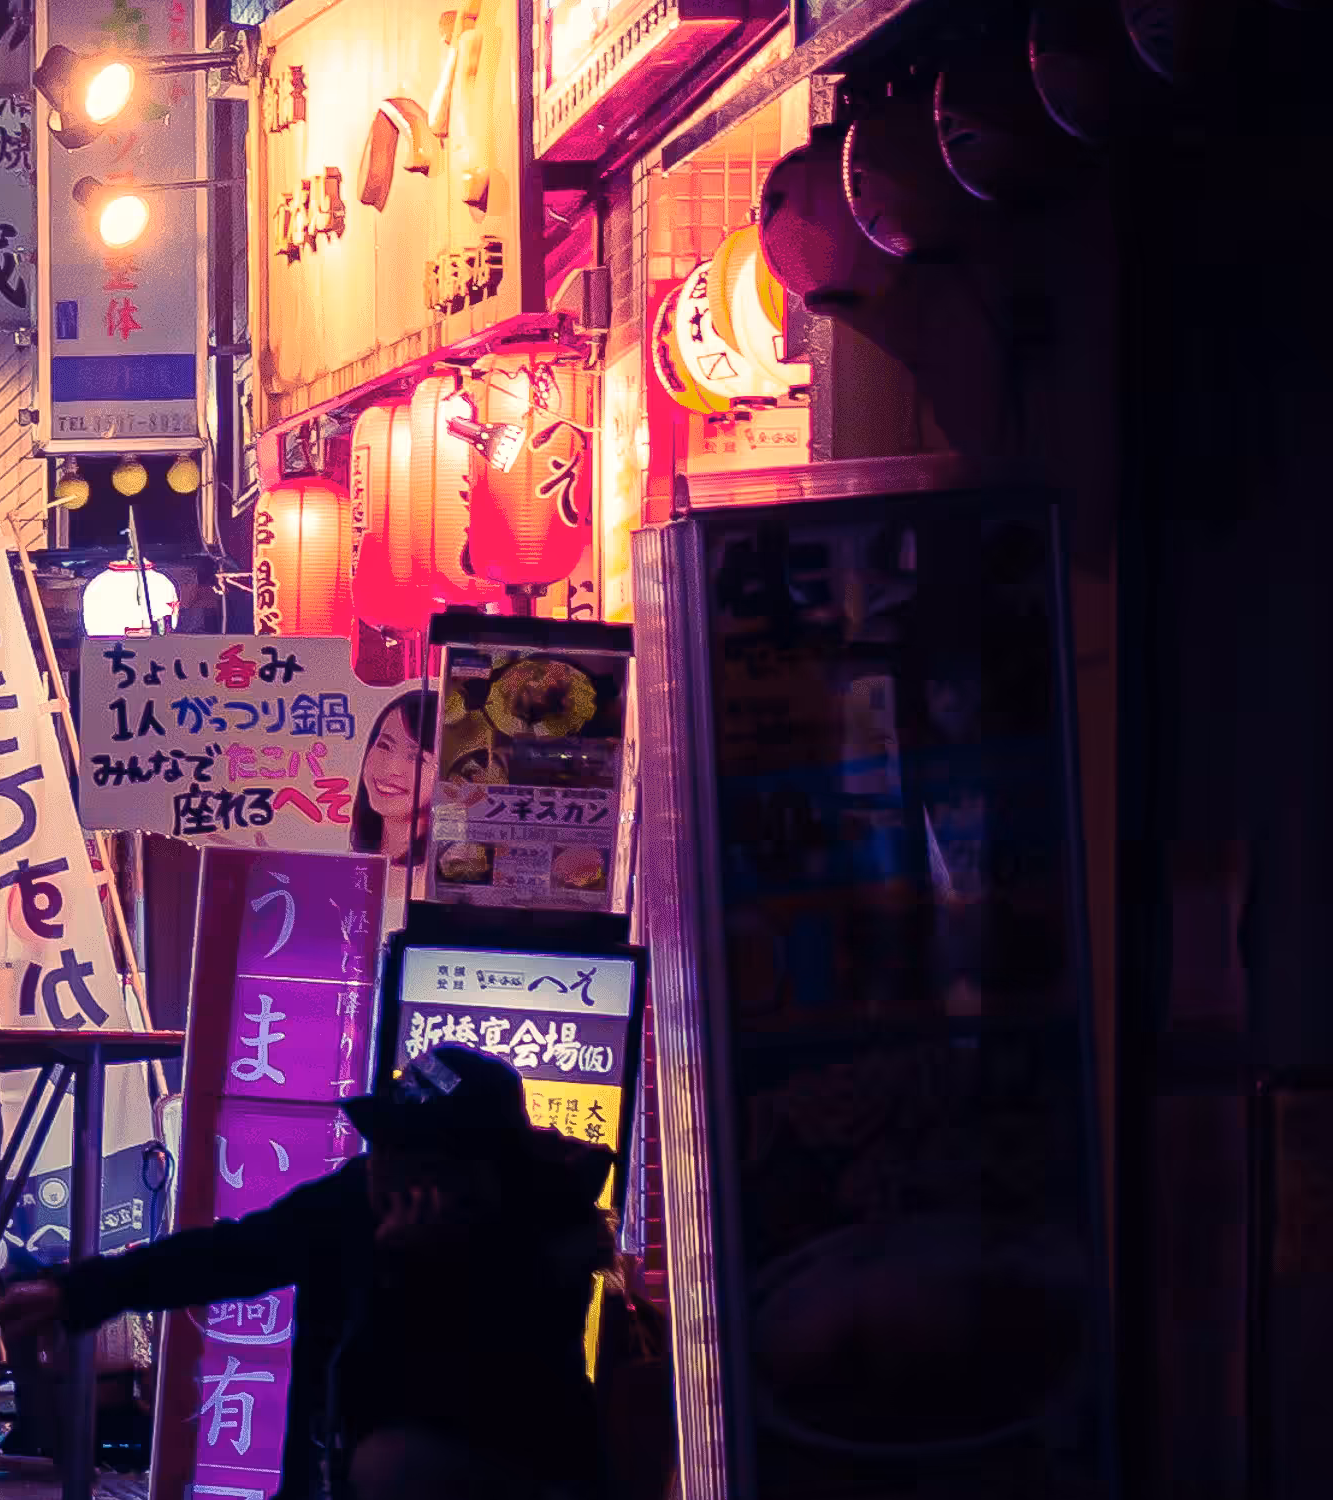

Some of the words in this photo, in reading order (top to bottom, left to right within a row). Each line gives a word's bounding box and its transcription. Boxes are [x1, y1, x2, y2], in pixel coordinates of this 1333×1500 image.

[103, 644, 306, 692] ちょい呑み
[109, 692, 357, 742] 1人がっつり鍋
[172, 777, 352, 838] 座れるへそ
[527, 967, 597, 1007] へそ
